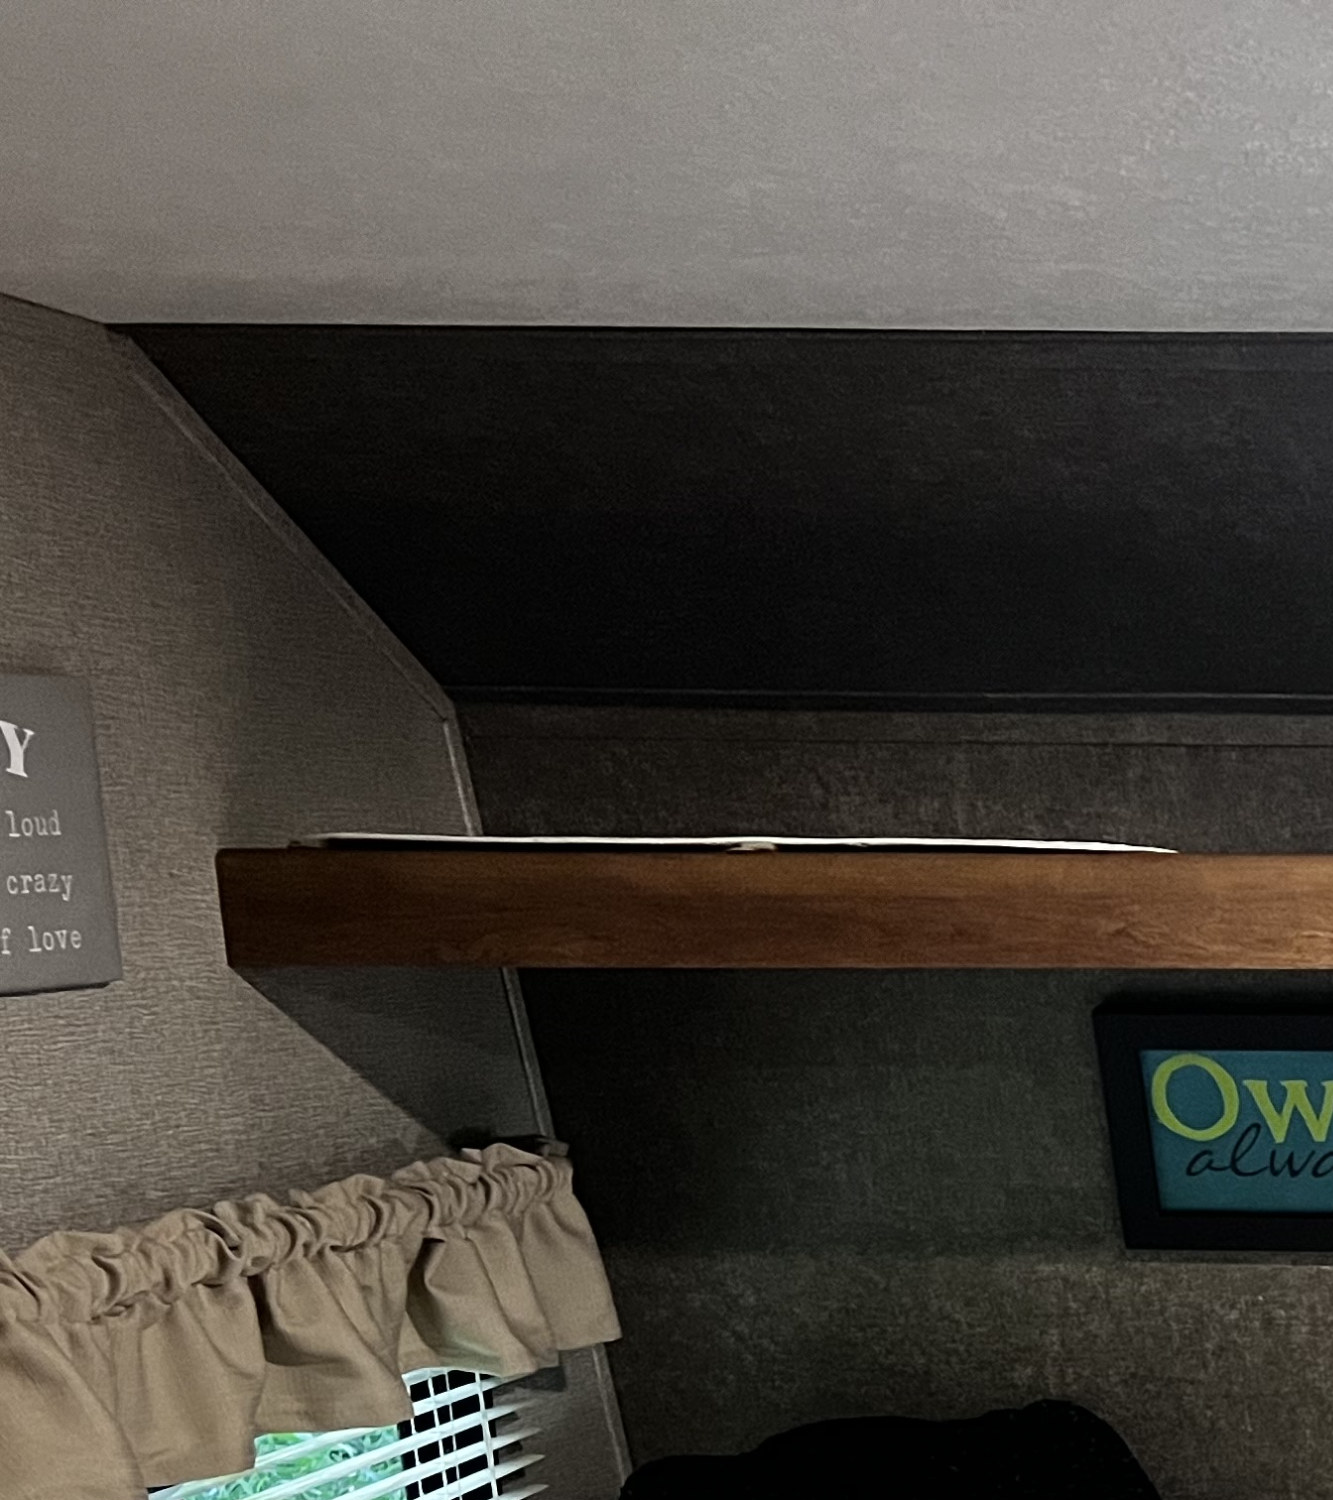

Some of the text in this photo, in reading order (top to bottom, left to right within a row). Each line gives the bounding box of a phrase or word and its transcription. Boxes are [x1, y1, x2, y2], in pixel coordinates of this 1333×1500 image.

[5, 810, 62, 838] loud
[6, 872, 73, 902] crazy
[27, 925, 82, 952] love
